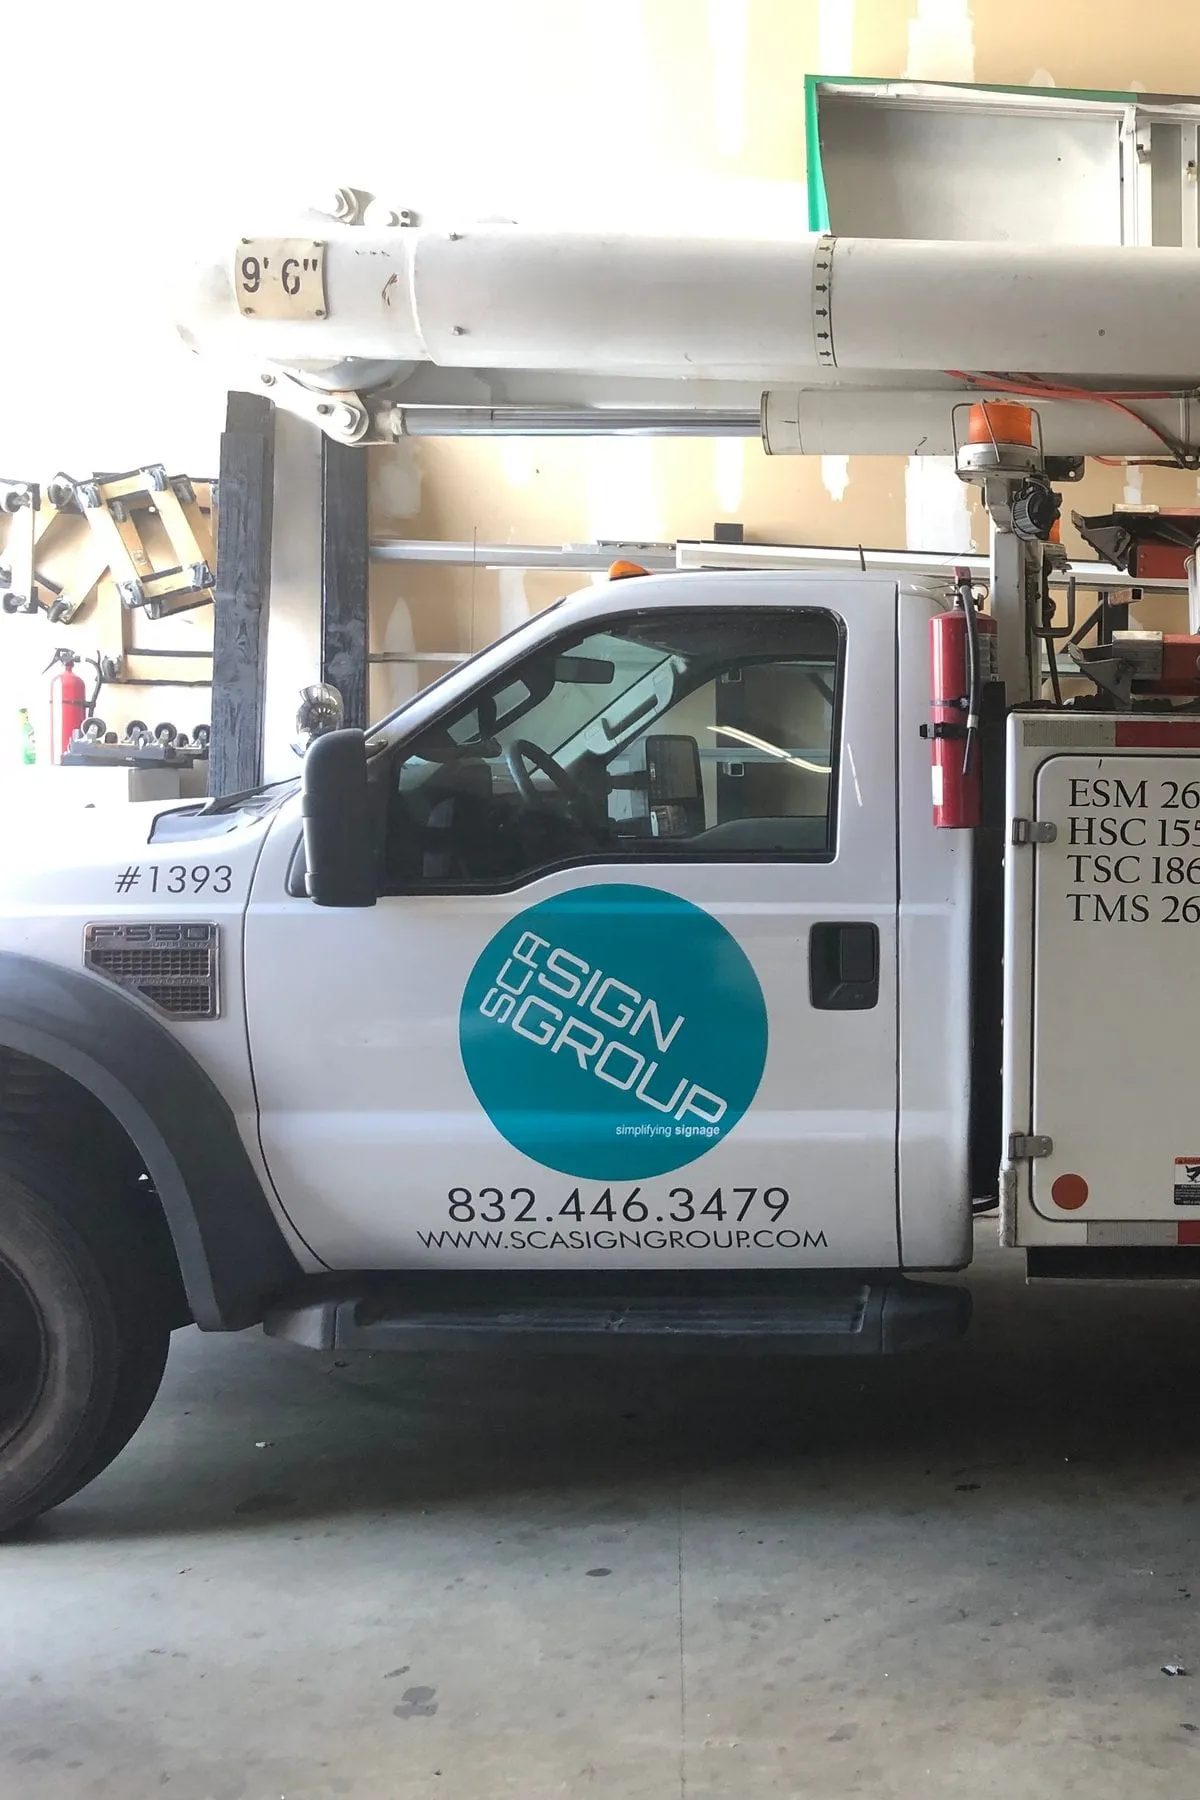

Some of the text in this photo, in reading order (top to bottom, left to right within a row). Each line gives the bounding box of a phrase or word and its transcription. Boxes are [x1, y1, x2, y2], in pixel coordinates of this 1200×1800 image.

[1068, 778, 1149, 808] ESM
[1067, 816, 1147, 846] HSC
[115, 865, 232, 894] #1393
[1066, 854, 1141, 884] TSC
[1066, 893, 1150, 923] TMS
[537, 947, 685, 1053] SIGN
[511, 995, 728, 1123] GROUP
[615, 1124, 720, 1137] simplifying signage
[447, 1186, 790, 1223] 832.446.3479
[417, 1229, 828, 1249] WWW.SCASIGNGROUP.COM
